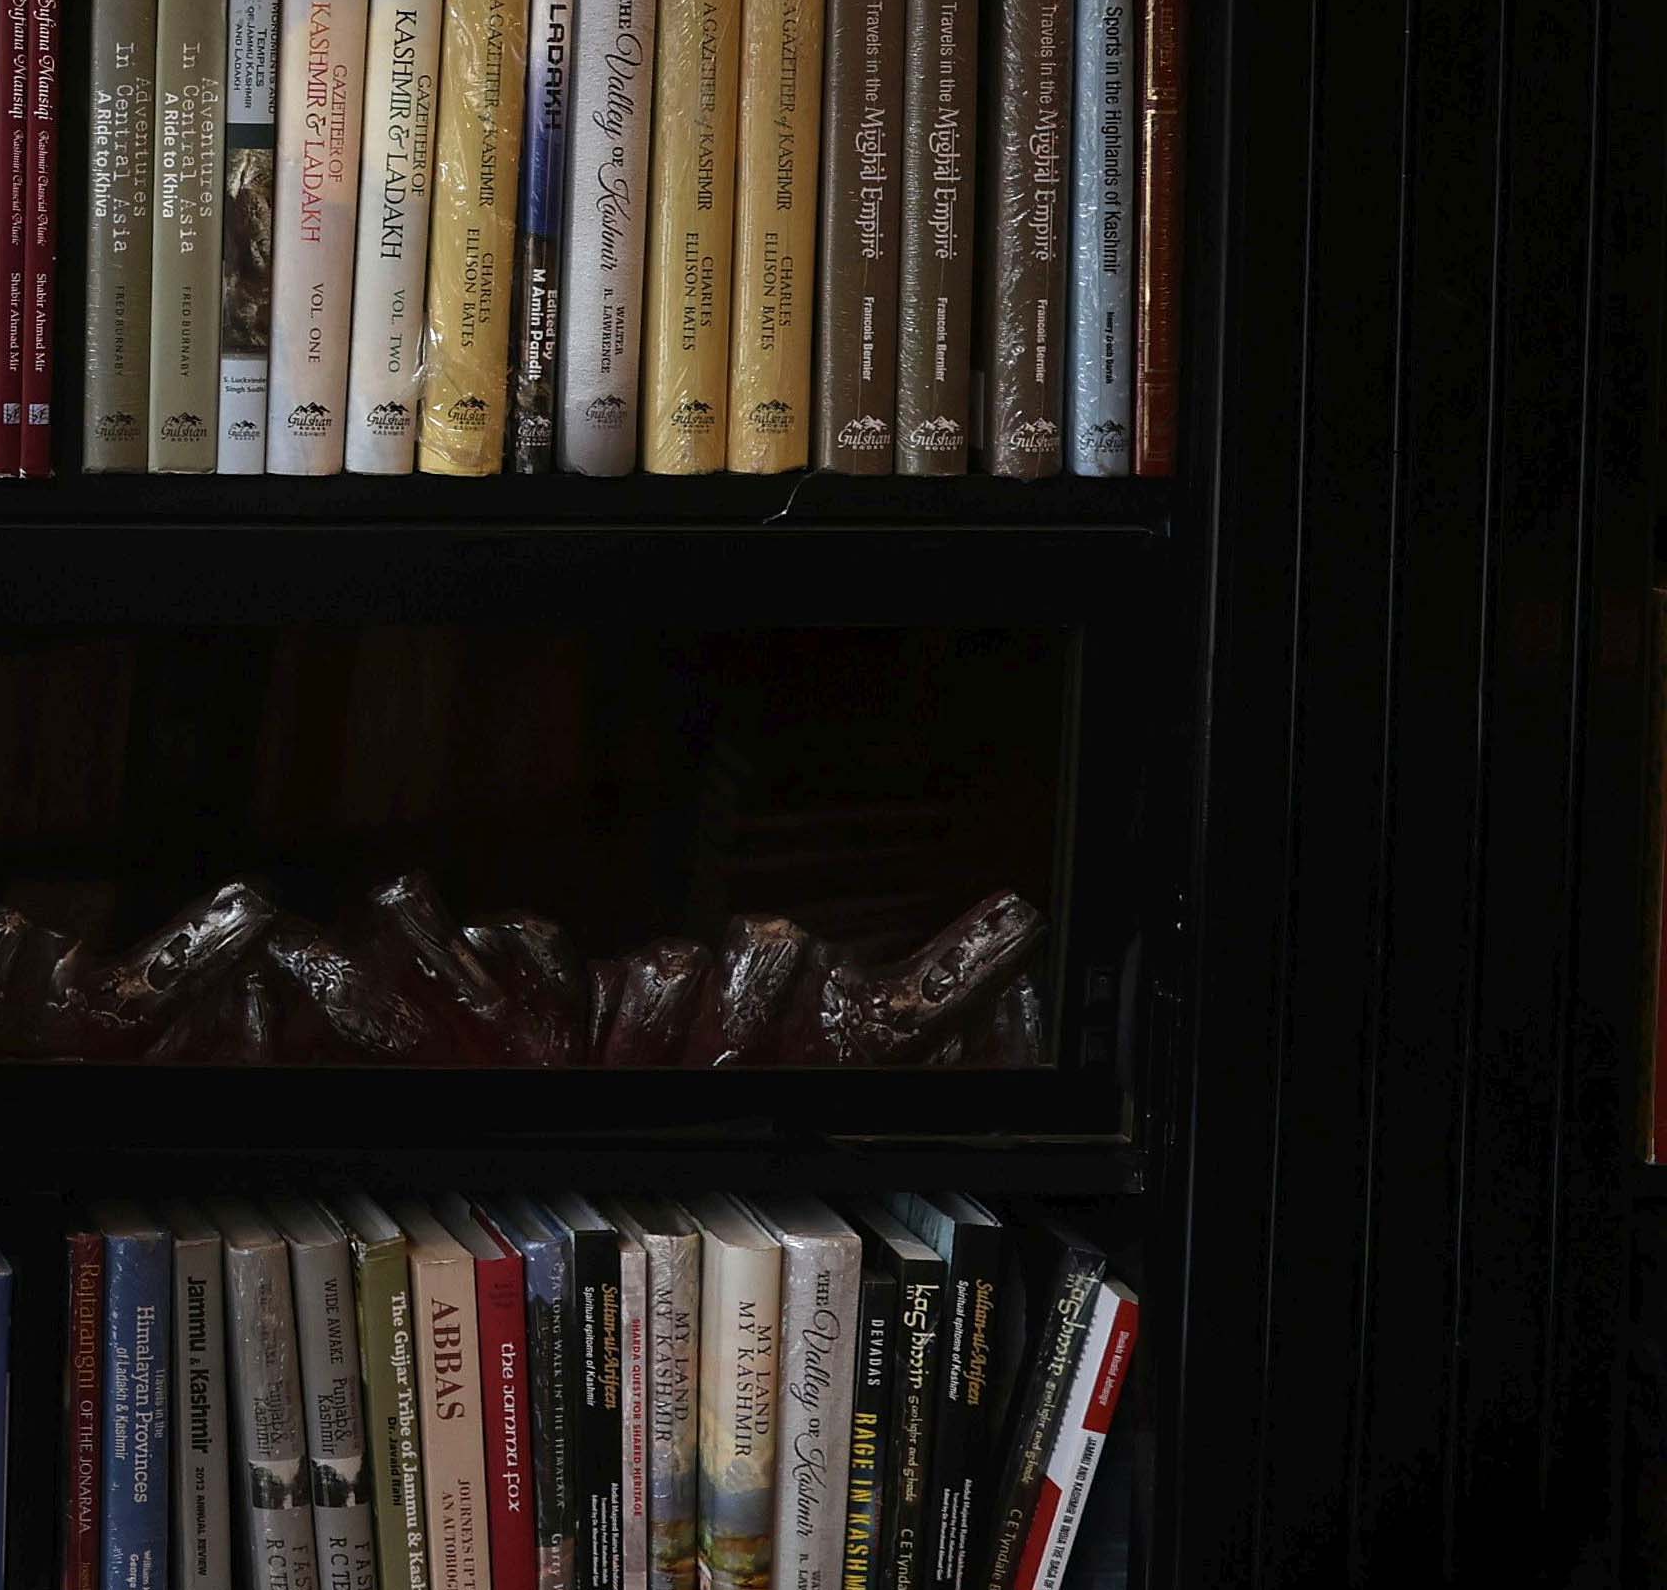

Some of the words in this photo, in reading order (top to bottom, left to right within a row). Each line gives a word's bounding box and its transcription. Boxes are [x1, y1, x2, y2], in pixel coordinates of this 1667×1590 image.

[389, 10, 416, 119] KASHMIR
[592, 33, 644, 139] Valley
[387, 124, 414, 149] &
[612, 146, 624, 167] OF
[381, 153, 406, 259] LADAKH
[595, 168, 630, 271] Kashmir
[391, 290, 405, 325] VOL.
[388, 335, 401, 373] TWO
[187, 1276, 207, 1351] Jammu
[739, 1301, 755, 1336] MY
[757, 1325, 771, 1356] MY
[133, 1305, 154, 1407] Himalayan
[431, 1298, 465, 1421] ABBAS
[189, 1369, 211, 1453] Kashmir
[735, 1347, 755, 1457] KASHMIR
[755, 1371, 770, 1435] LAND
[133, 1411, 152, 1503] Provinces
